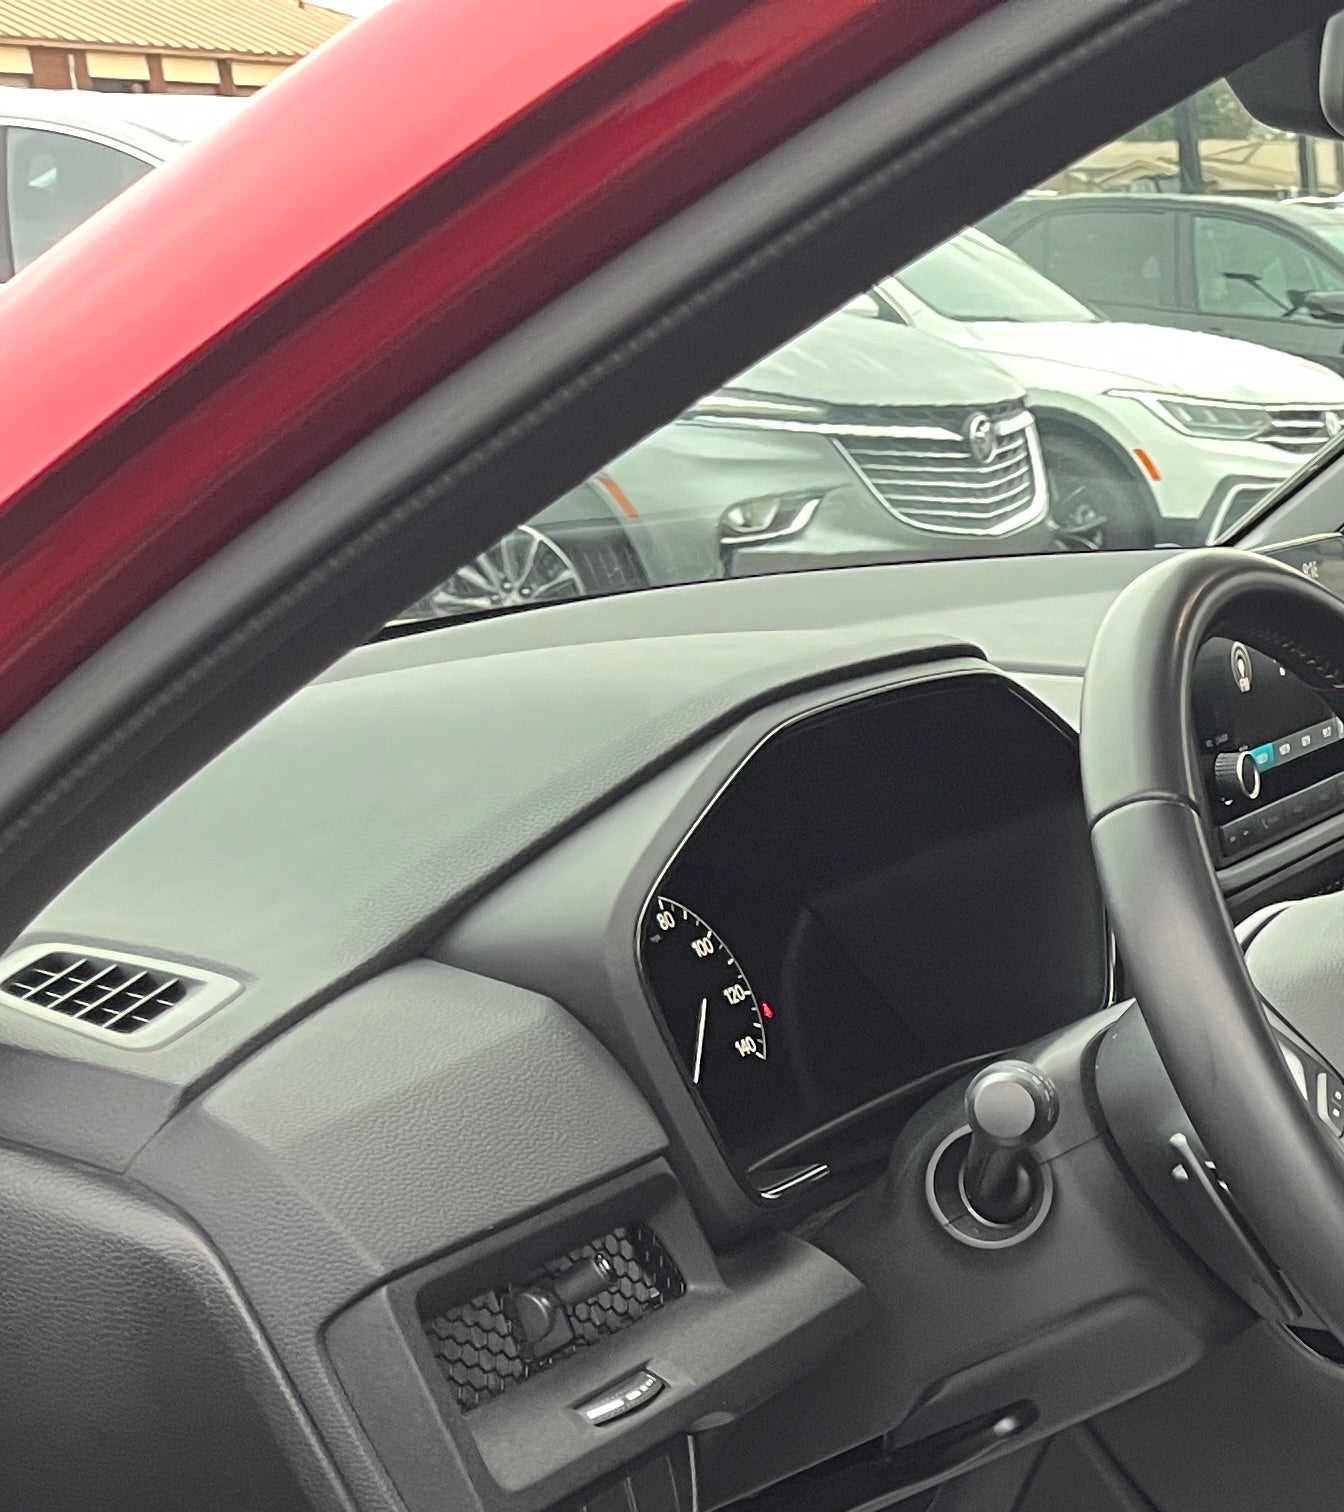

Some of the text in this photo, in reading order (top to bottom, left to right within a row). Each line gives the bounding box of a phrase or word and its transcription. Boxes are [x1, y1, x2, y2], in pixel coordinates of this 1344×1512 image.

[656, 910, 676, 931] 80
[691, 937, 714, 958] 100
[722, 984, 746, 1005] 120
[734, 1036, 757, 1057] 140
